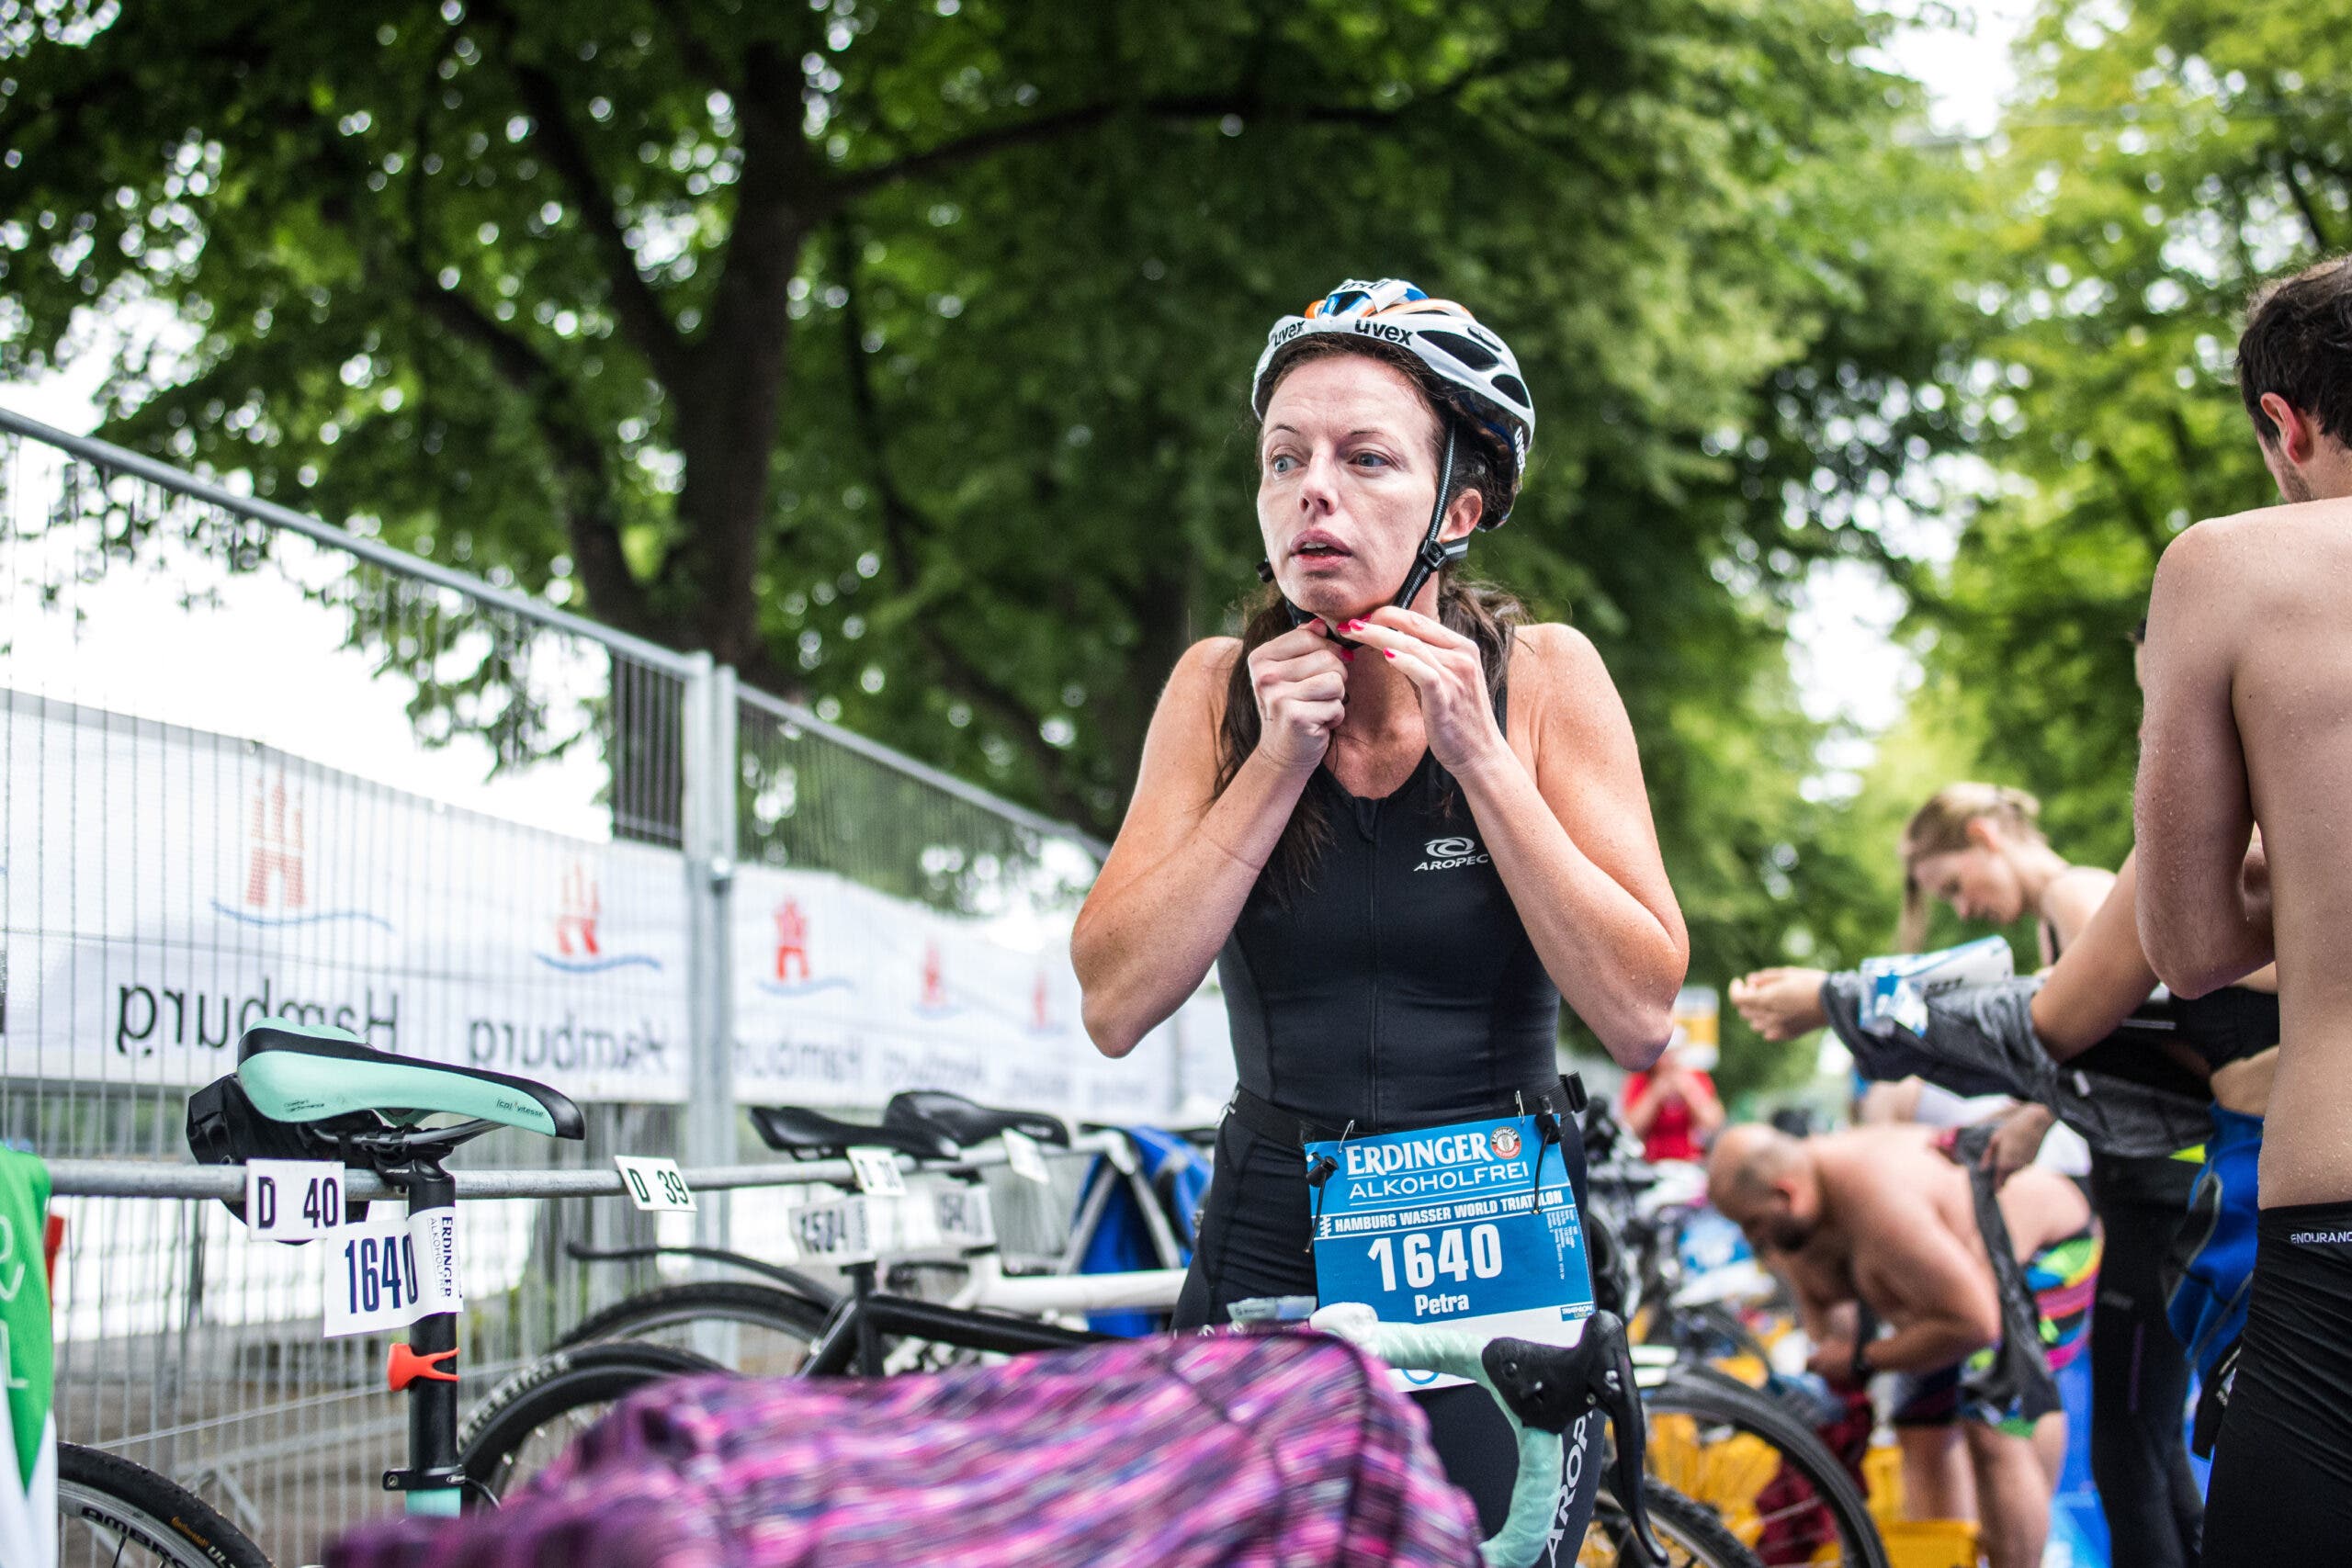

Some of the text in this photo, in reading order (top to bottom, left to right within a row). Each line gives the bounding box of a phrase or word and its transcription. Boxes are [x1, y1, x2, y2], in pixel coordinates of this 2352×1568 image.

[1273, 321, 1306, 347] uvex
[1354, 319, 1413, 345] uvex
[1413, 853, 1488, 872] AROPEC
[1345, 1132, 1494, 1177] ERDINGER
[627, 1168, 689, 1204] D 39
[1349, 1161, 1530, 1200] ALKOHOLFREI
[258, 1176, 338, 1230] D 40
[1335, 1213, 1396, 1233] HAMBURG
[1399, 1206, 1452, 1228] WASSER
[1454, 1199, 1499, 1220] WORLD
[345, 1231, 419, 1314] 1640
[441, 1216, 454, 1297] ERDINGER
[1367, 1224, 1502, 1292] 1640
[1414, 1293, 1470, 1316] Petra
